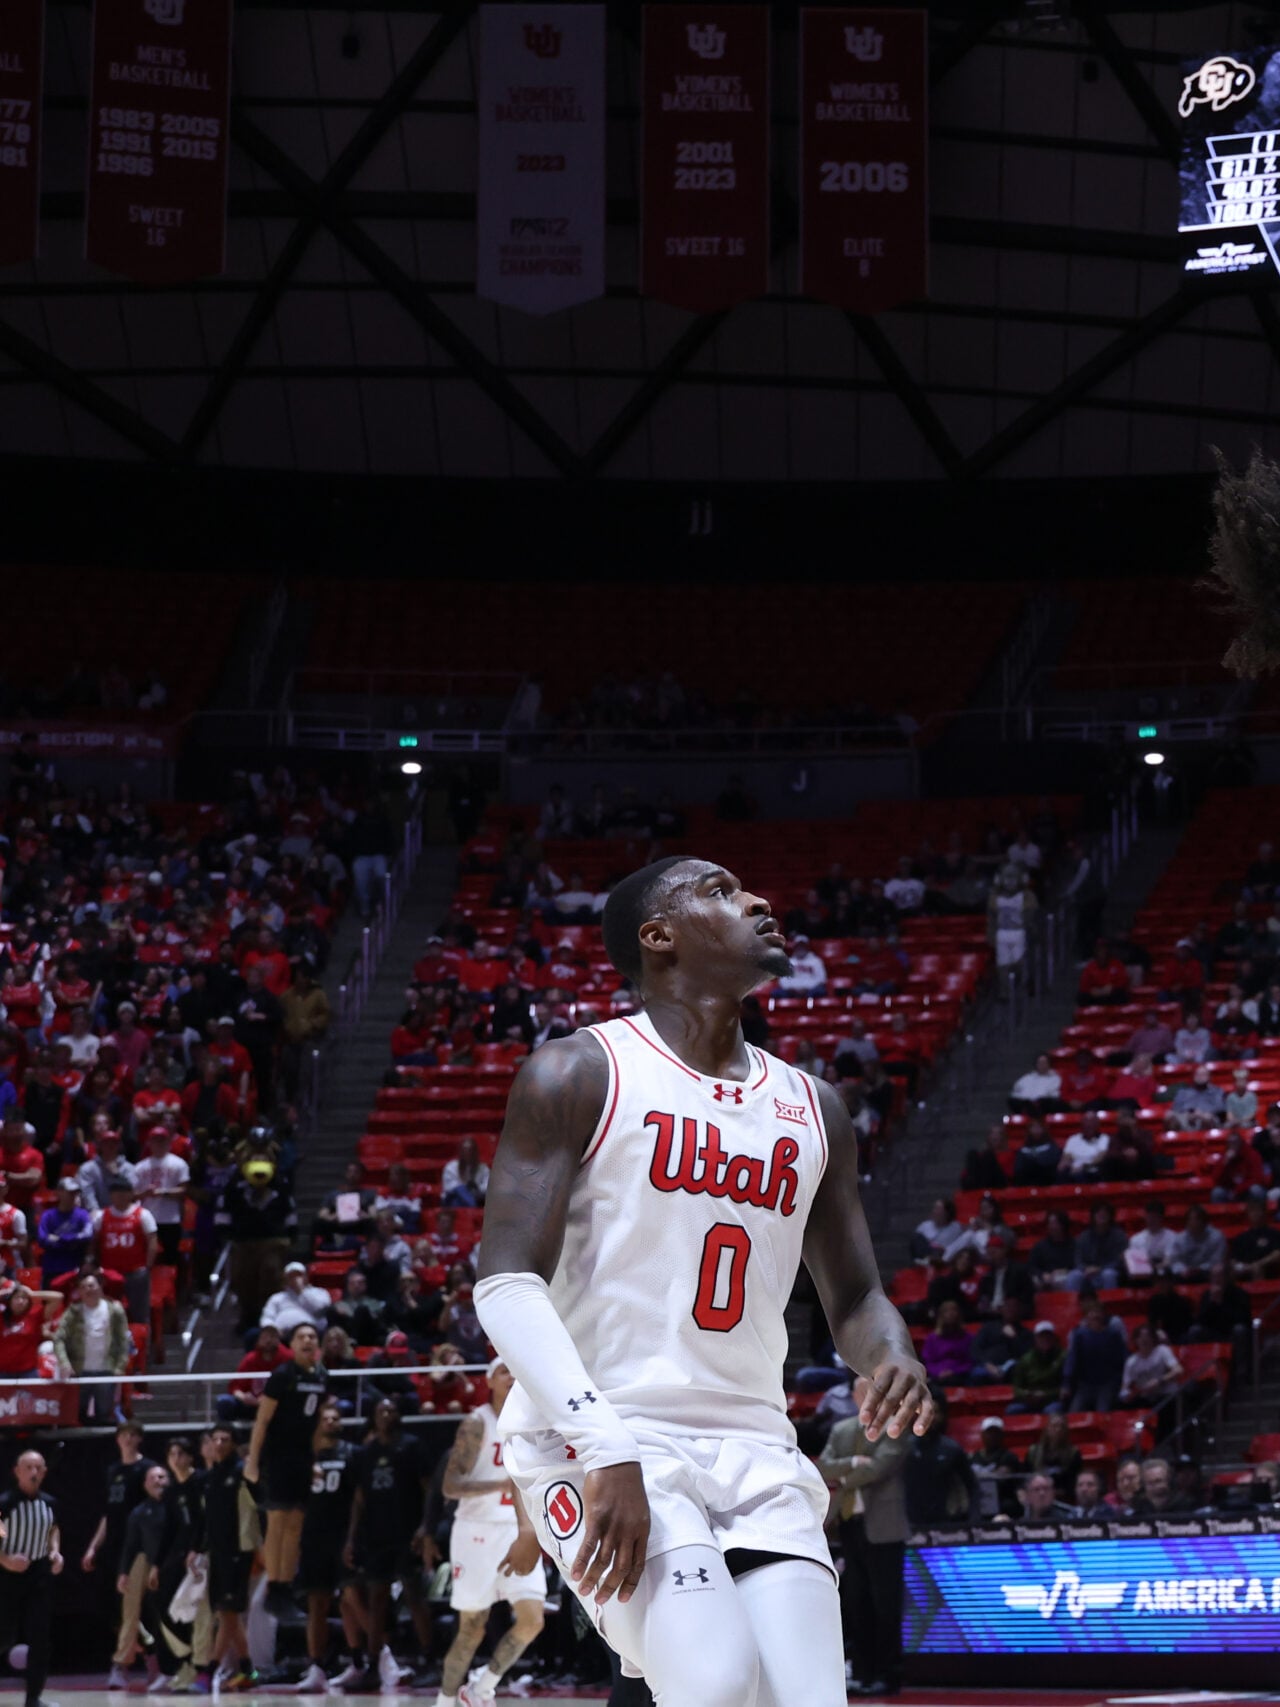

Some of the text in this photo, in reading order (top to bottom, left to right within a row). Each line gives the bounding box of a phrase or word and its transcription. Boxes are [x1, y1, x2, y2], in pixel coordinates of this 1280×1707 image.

[136, 44, 187, 67] MEN'S
[108, 61, 211, 91] BASKETBALL
[674, 74, 743, 95] WOMEN'S
[506, 86, 576, 105] WOMEN'S
[660, 92, 754, 114] BASKETBALL
[828, 81, 900, 102] WOMEN'S
[98, 106, 220, 138] 1983 2005
[494, 101, 586, 123] BASKETBALL
[814, 101, 912, 123] BASKETBALL
[100, 129, 218, 161] 1991 2015
[675, 140, 736, 164] 2001
[96, 152, 154, 177] 1996
[516, 154, 567, 173] 2023
[673, 167, 737, 191] 2023
[818, 161, 910, 194] 2006
[128, 204, 184, 227] SWEET
[145, 226, 167, 247] 16
[664, 236, 746, 258] SWEET 16
[842, 238, 885, 258] ELITE
[499, 257, 584, 278] CHAMPIONS
[1184, 256, 1232, 270] AMERICA
[1233, 252, 1267, 266] FIRST
[791, 768, 807, 793] J
[643, 1109, 801, 1218] Utah
[691, 1221, 753, 1333] 0
[1133, 1578, 1268, 1611] AMERICA
